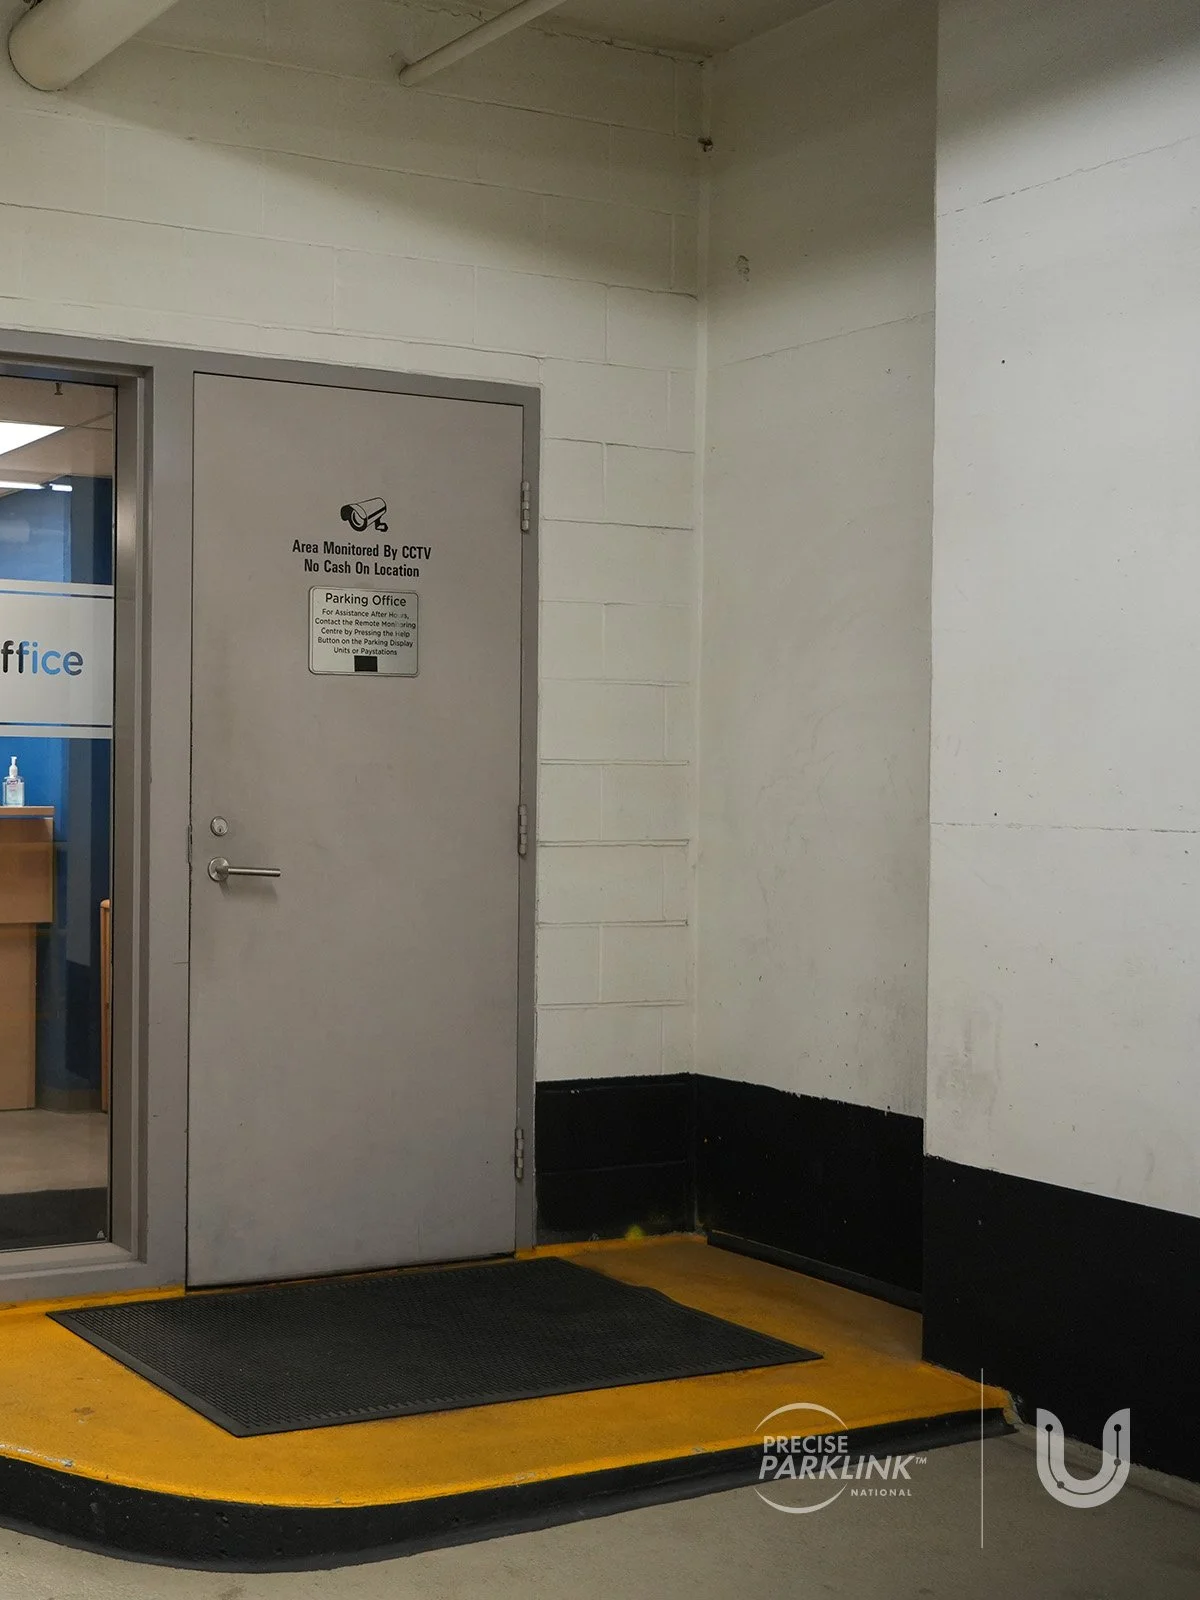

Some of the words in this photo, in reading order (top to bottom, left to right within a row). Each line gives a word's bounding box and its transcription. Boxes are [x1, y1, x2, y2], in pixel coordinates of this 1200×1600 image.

[292, 539, 319, 554] Area
[323, 541, 380, 557] Monitored
[383, 544, 398, 561] By
[402, 545, 432, 560] CCTV
[304, 558, 319, 572] No
[324, 560, 351, 574] Cash
[355, 561, 370, 575] On
[374, 562, 420, 578] Location
[325, 592, 369, 607] Parking
[372, 594, 407, 607] Office
[322, 608, 333, 616] For
[335, 609, 369, 617] Assistance
[371, 610, 387, 618] After
[388, 611, 410, 620] Hors,
[314, 617, 341, 626] Contact
[355, 619, 380, 627] Remote
[321, 627, 343, 635] Centre
[344, 628, 352, 637] by
[354, 628, 382, 638] Pressing
[382, 629, 394, 637] the
[317, 636, 340, 644] Button
[363, 638, 389, 647] Parking
[389, 639, 414, 649] Display
[333, 646, 350, 654] Units
[360, 647, 398, 656] Paystations
